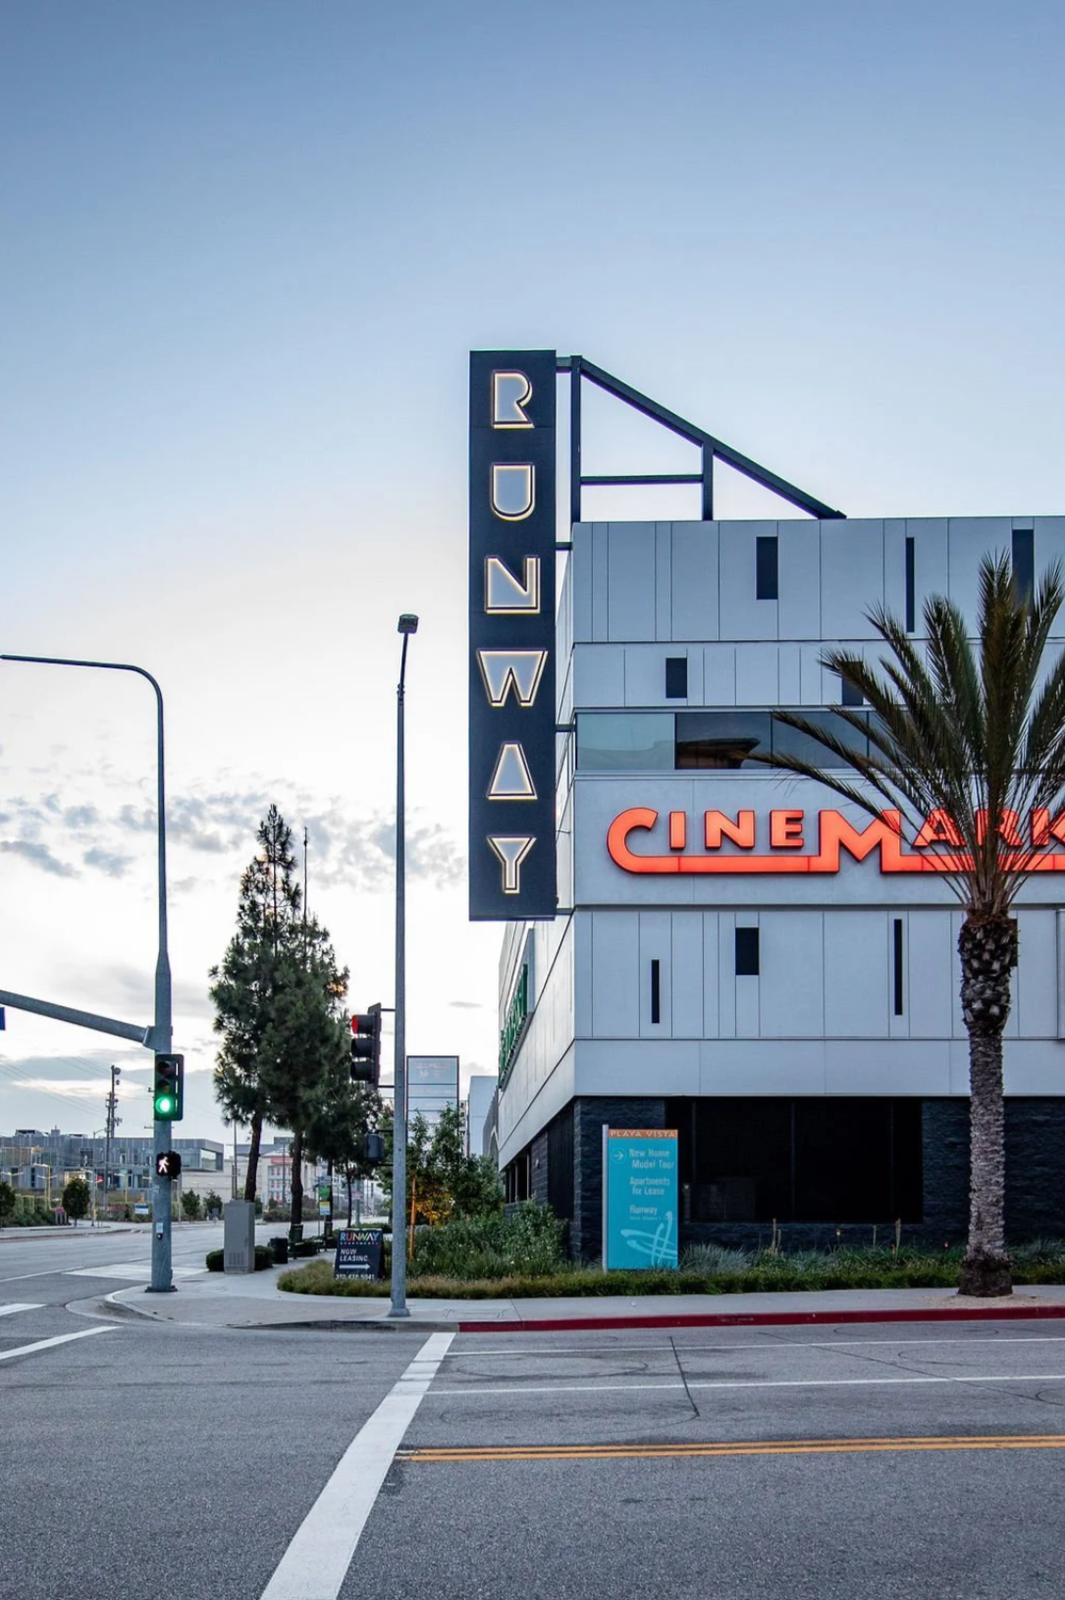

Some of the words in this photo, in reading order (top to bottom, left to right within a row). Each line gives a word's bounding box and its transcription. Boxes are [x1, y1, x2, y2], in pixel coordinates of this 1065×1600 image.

[477, 369, 549, 895] RUNWAY
[606, 806, 1065, 875] CINEMARK
[609, 1129, 641, 1138] PLAYA
[646, 1129, 676, 1138] VISTA
[632, 1159, 656, 1169] Model
[644, 1186, 665, 1195] Lease
[340, 1231, 380, 1241] RUNWAY
